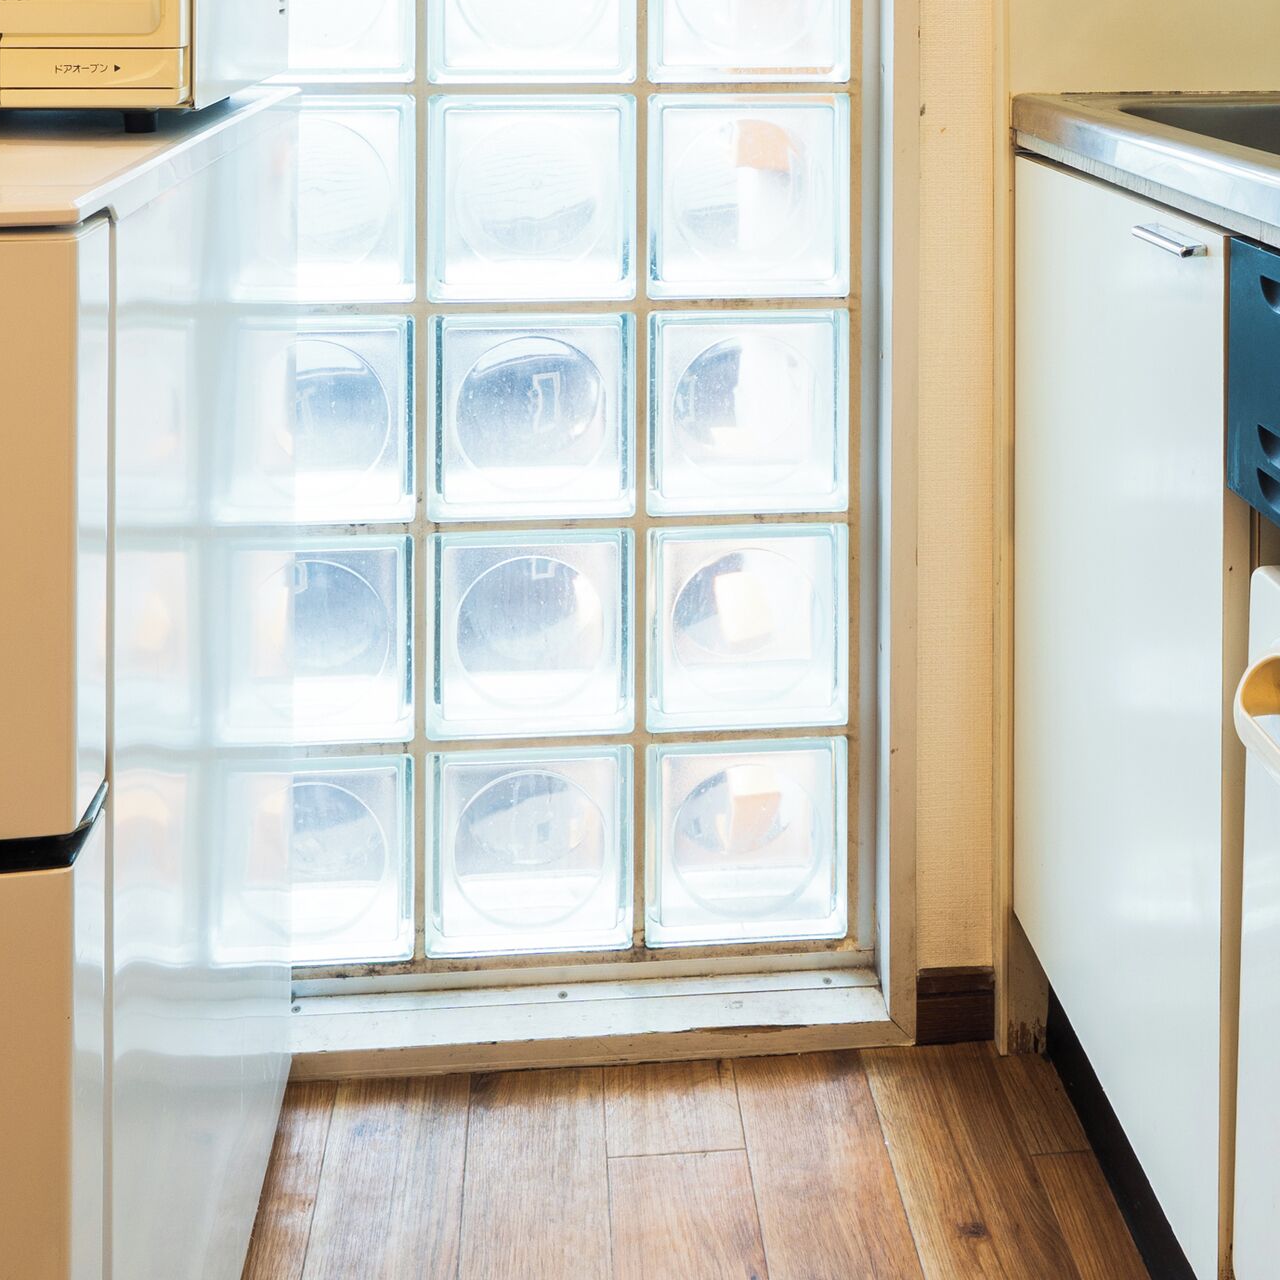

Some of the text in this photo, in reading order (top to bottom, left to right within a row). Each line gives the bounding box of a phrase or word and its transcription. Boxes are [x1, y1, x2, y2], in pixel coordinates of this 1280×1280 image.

[55, 63, 108, 74] ドアオープン
